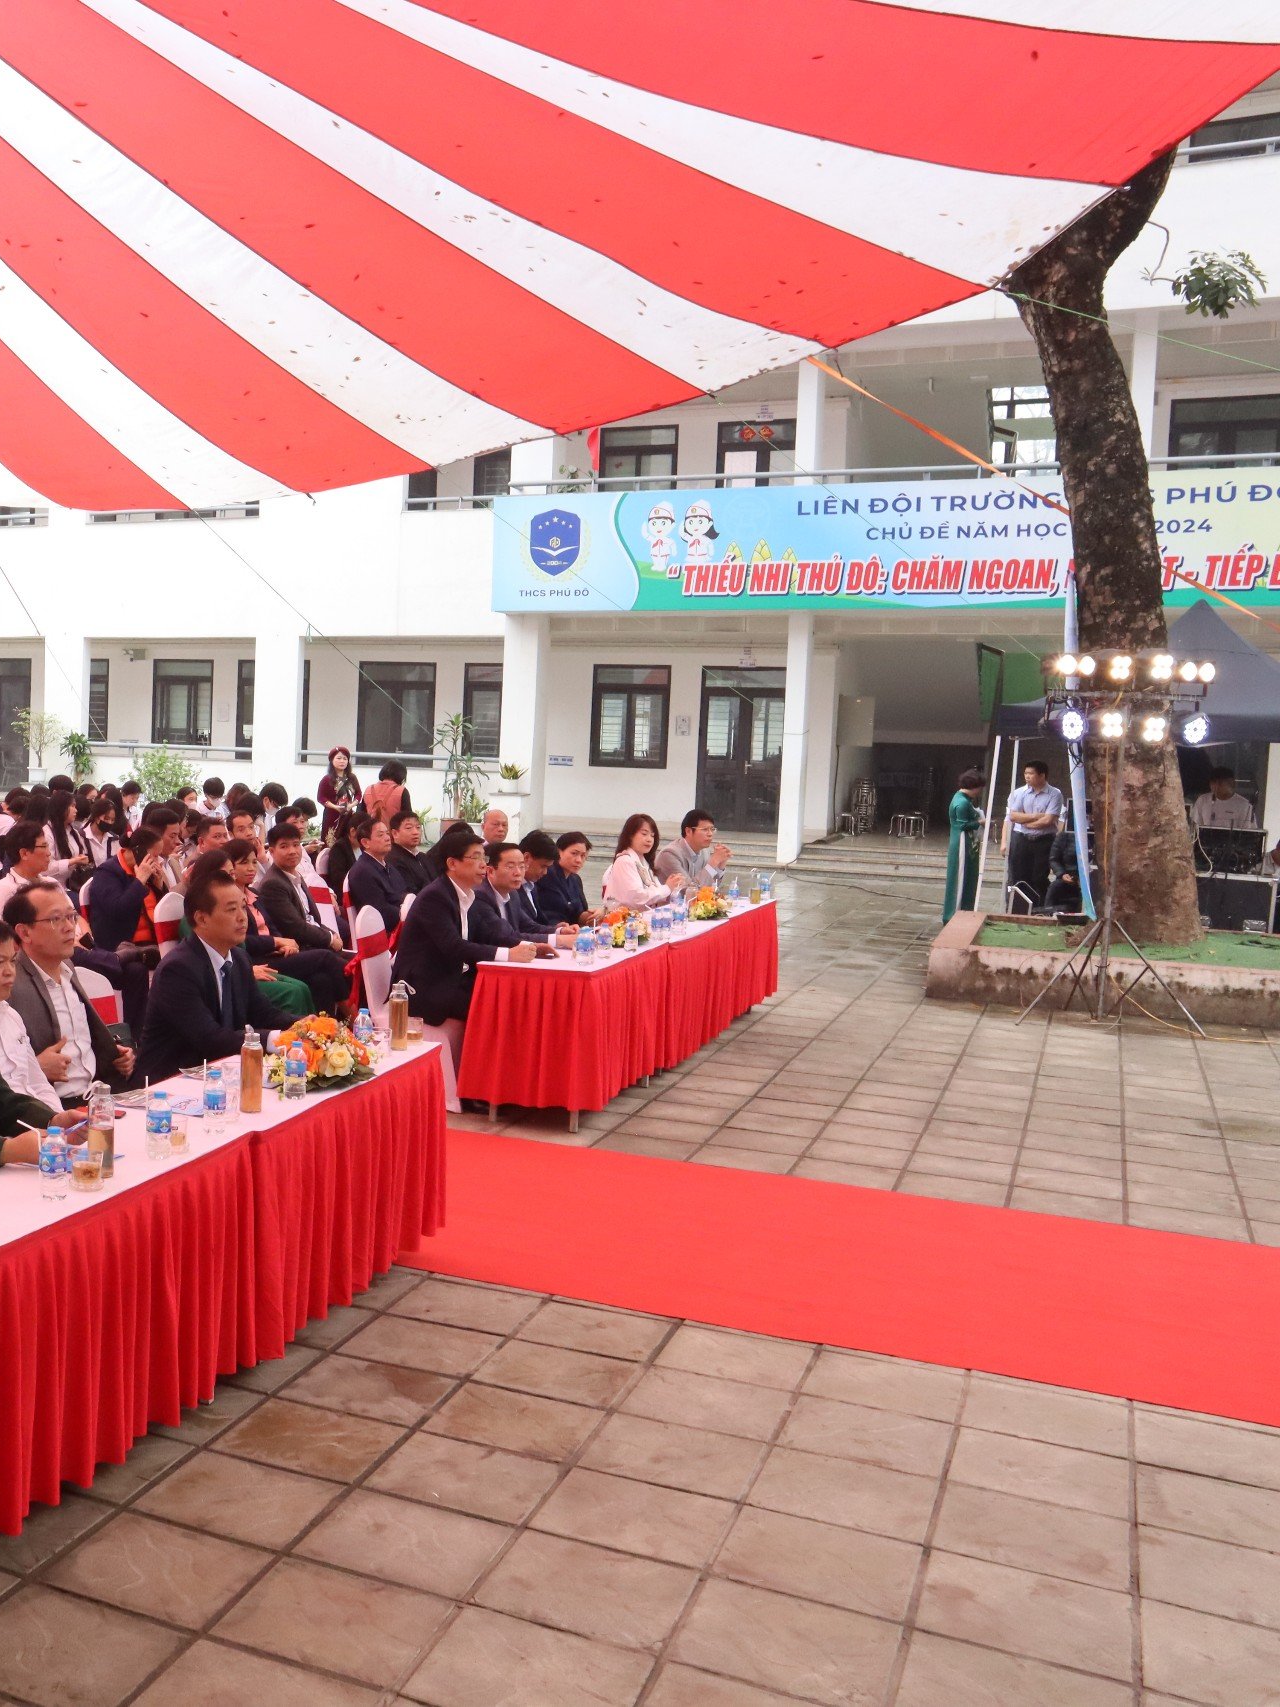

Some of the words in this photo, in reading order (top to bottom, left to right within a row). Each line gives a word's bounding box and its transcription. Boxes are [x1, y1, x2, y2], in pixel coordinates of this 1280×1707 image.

[797, 495, 860, 516] LIÊN
[867, 493, 922, 517] ĐỘI
[931, 490, 1062, 512] TRƯỜNG
[1166, 480, 1237, 505] PHÚ
[1247, 484, 1280, 502] Đ
[866, 521, 912, 540] CHỦ
[918, 520, 950, 540] ĐỀ
[956, 521, 1009, 539] NĂM
[1016, 522, 1067, 541] HỌC
[683, 554, 747, 593] THIẾU
[749, 562, 791, 592] NHI
[796, 554, 843, 592] THỦ
[846, 556, 886, 591] ĐÔ:
[891, 554, 966, 591] CHĂM
[968, 557, 1057, 593] NGOAN,
[1205, 544, 1265, 587] TIẾP
[519, 589, 546, 597] THCS
[549, 587, 571, 597] PHÚ
[574, 587, 589, 597] ĐÔ
